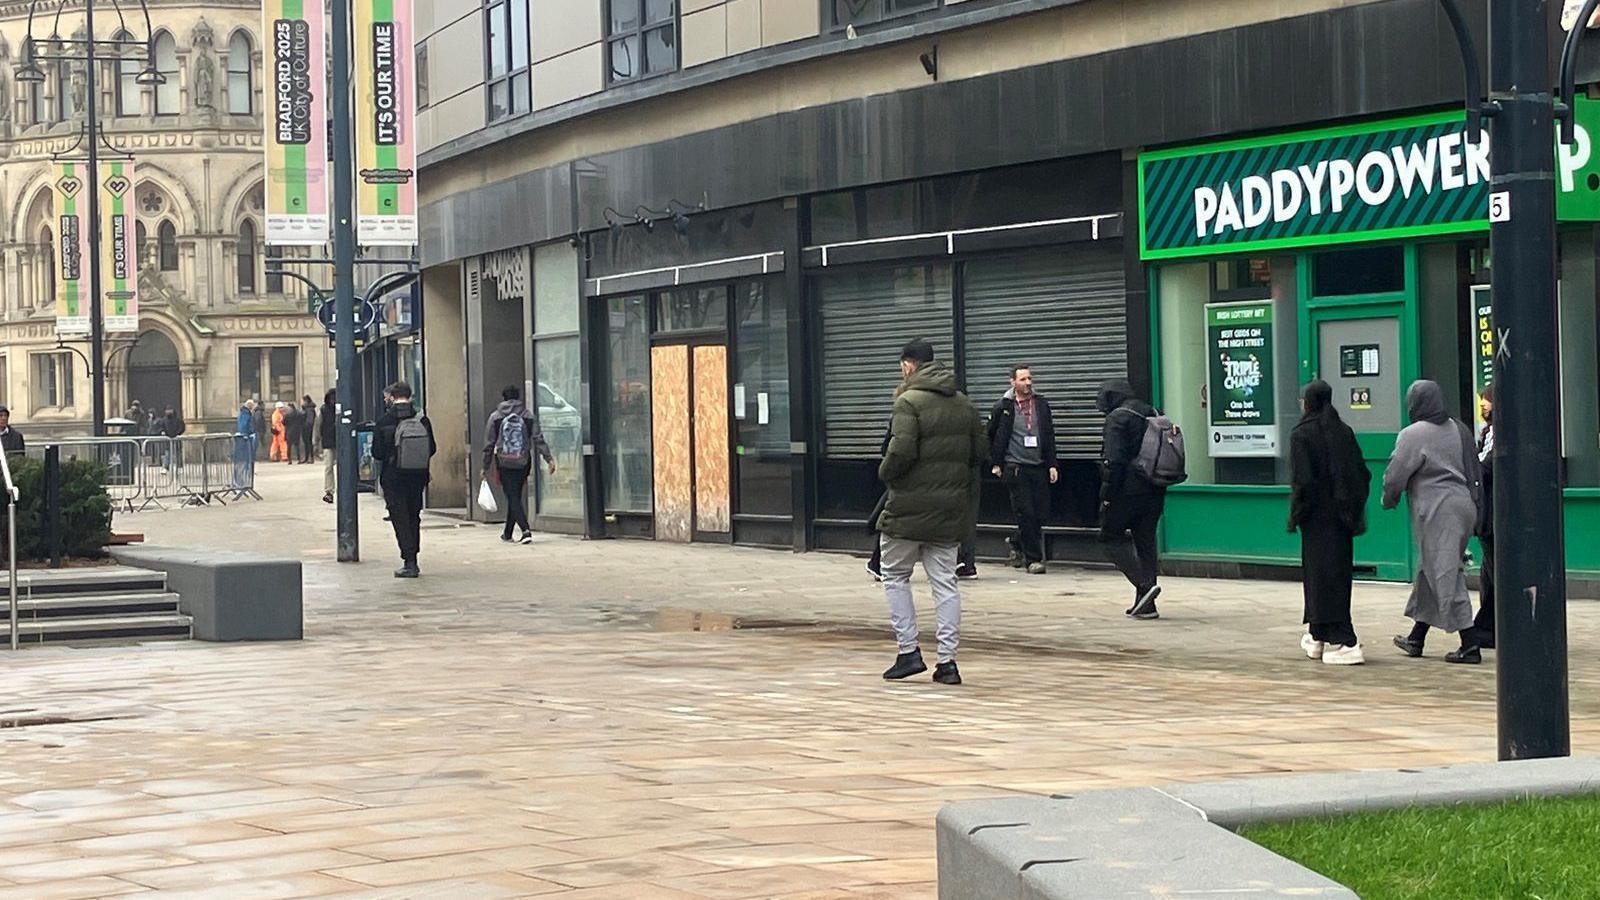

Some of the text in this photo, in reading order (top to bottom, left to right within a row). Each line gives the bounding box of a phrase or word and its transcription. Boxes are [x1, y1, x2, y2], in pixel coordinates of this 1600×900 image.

[278, 23, 292, 141] BRADFORD 2025
[292, 23, 310, 142] UK City of Culture
[376, 25, 393, 143] IT'S OUR TIME
[1194, 130, 1490, 237] PADDYPOWER
[1492, 196, 1502, 217] 5
[114, 216, 123, 238] TIME
[115, 240, 124, 260] OUR
[1250, 328, 1261, 337] ON
[1222, 360, 1260, 376] TRIPLE
[1224, 373, 1260, 389] CHANCE
[1230, 400, 1254, 409] One bet
